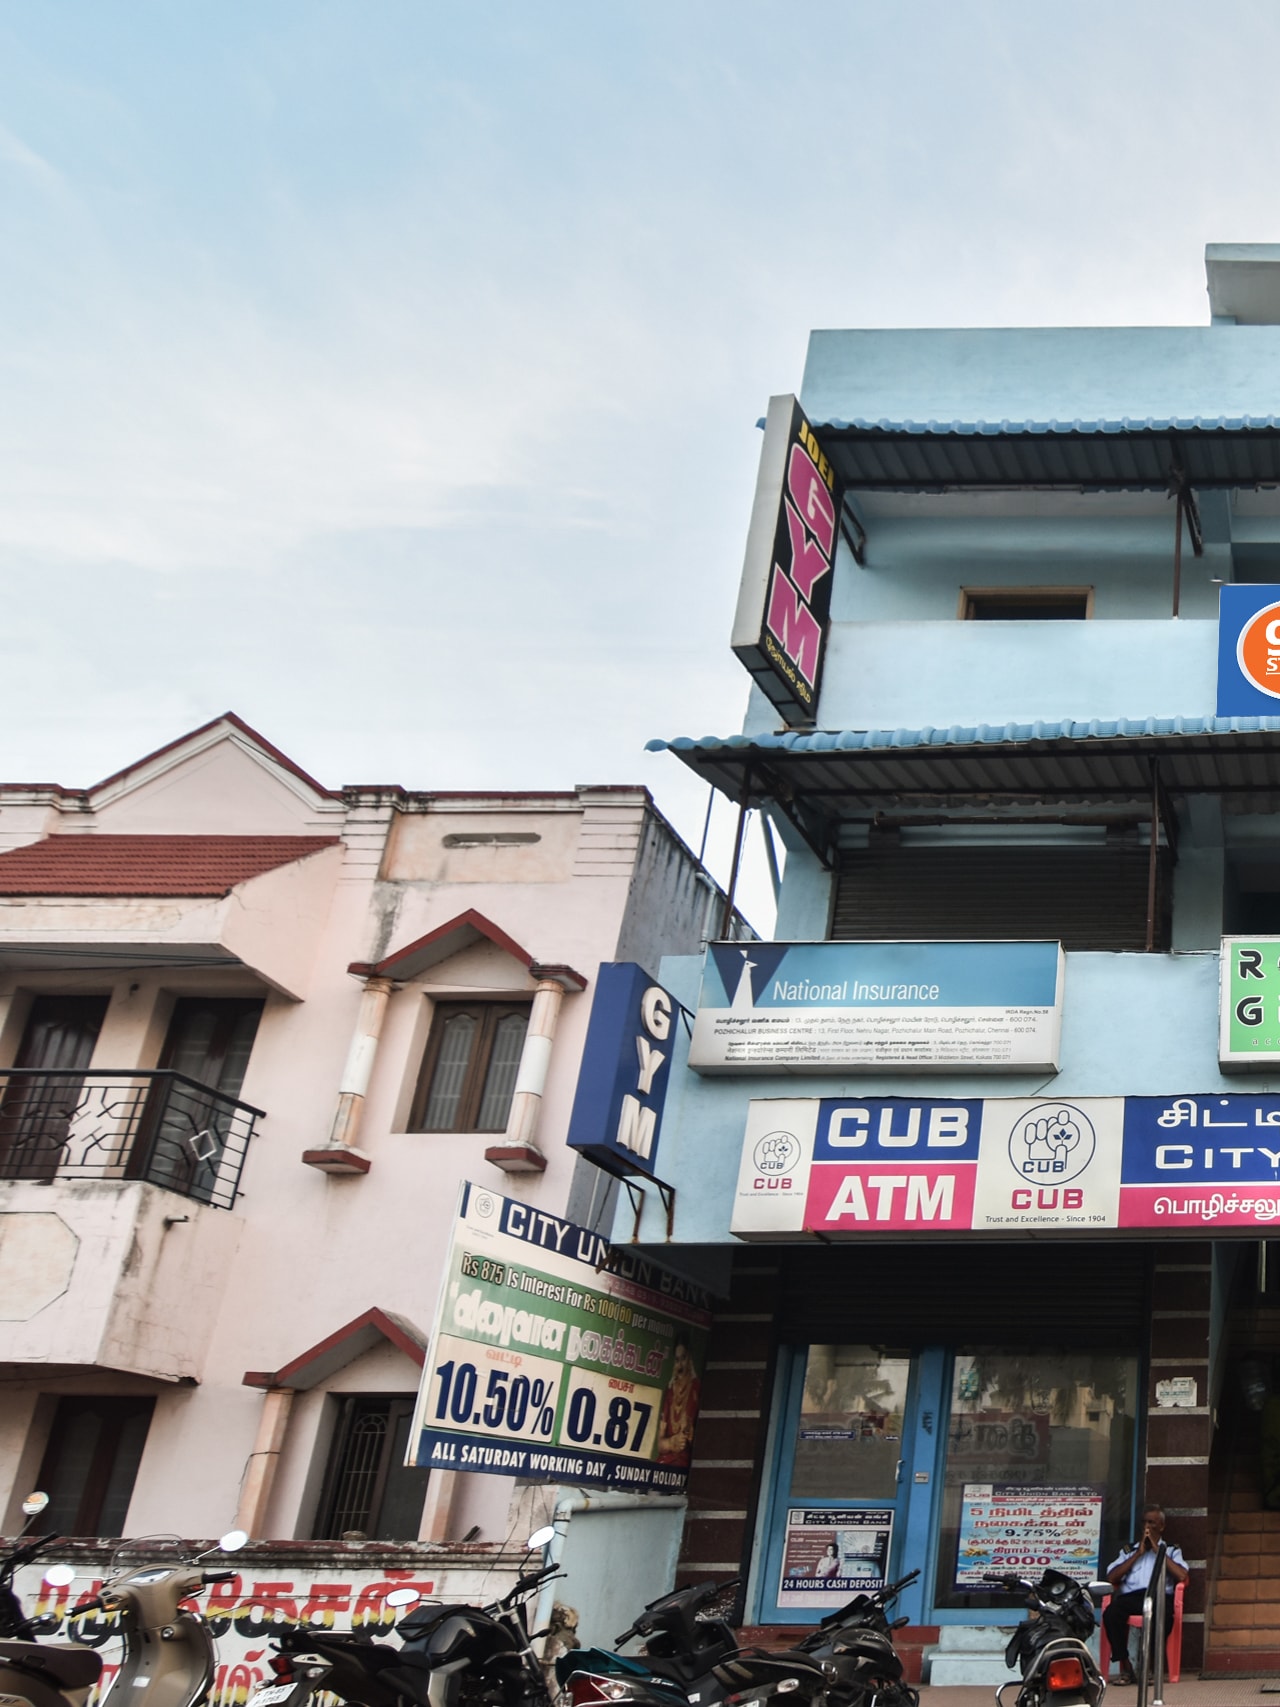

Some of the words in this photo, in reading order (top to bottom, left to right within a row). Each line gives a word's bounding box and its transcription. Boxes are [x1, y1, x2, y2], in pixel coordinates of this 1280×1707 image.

[767, 442, 836, 692] GYM
[772, 979, 846, 1001] National
[853, 980, 940, 1001] Insurance
[616, 986, 672, 1160] GYM
[827, 1107, 970, 1148] CUB
[753, 1177, 793, 1189] CUB
[1022, 1160, 1065, 1173] CUB
[824, 1174, 956, 1221] ATM
[1011, 1188, 1084, 1210] CUB
[506, 1203, 571, 1251] CITY
[985, 1215, 1003, 1223] Trust
[1004, 1215, 1019, 1223] and
[1020, 1215, 1058, 1223] Excellence
[1066, 1215, 1086, 1223] Since
[1087, 1215, 1106, 1223] 1904
[462, 1252, 478, 1277] Rs
[480, 1259, 504, 1284] 875
[507, 1268, 518, 1288] Is
[520, 1271, 565, 1302] Interest
[566, 1286, 583, 1308] For
[583, 1292, 597, 1313] Rs
[434, 1360, 554, 1436] 10.50%
[566, 1387, 653, 1452] 0.87
[431, 1441, 456, 1461] ALL
[460, 1446, 526, 1469] SATURDAY
[529, 1453, 583, 1475] WORKING
[586, 1460, 606, 1478] DAY
[614, 1464, 651, 1482] SUNDAY
[652, 1470, 687, 1488] HOLIDAY
[970, 1507, 983, 1516] 5
[1005, 1529, 1061, 1537] 9.75%
[783, 1579, 795, 1589] 24
[795, 1579, 824, 1589] HOURS
[826, 1579, 848, 1589] CASH
[849, 1579, 883, 1588] DEPOSIT
